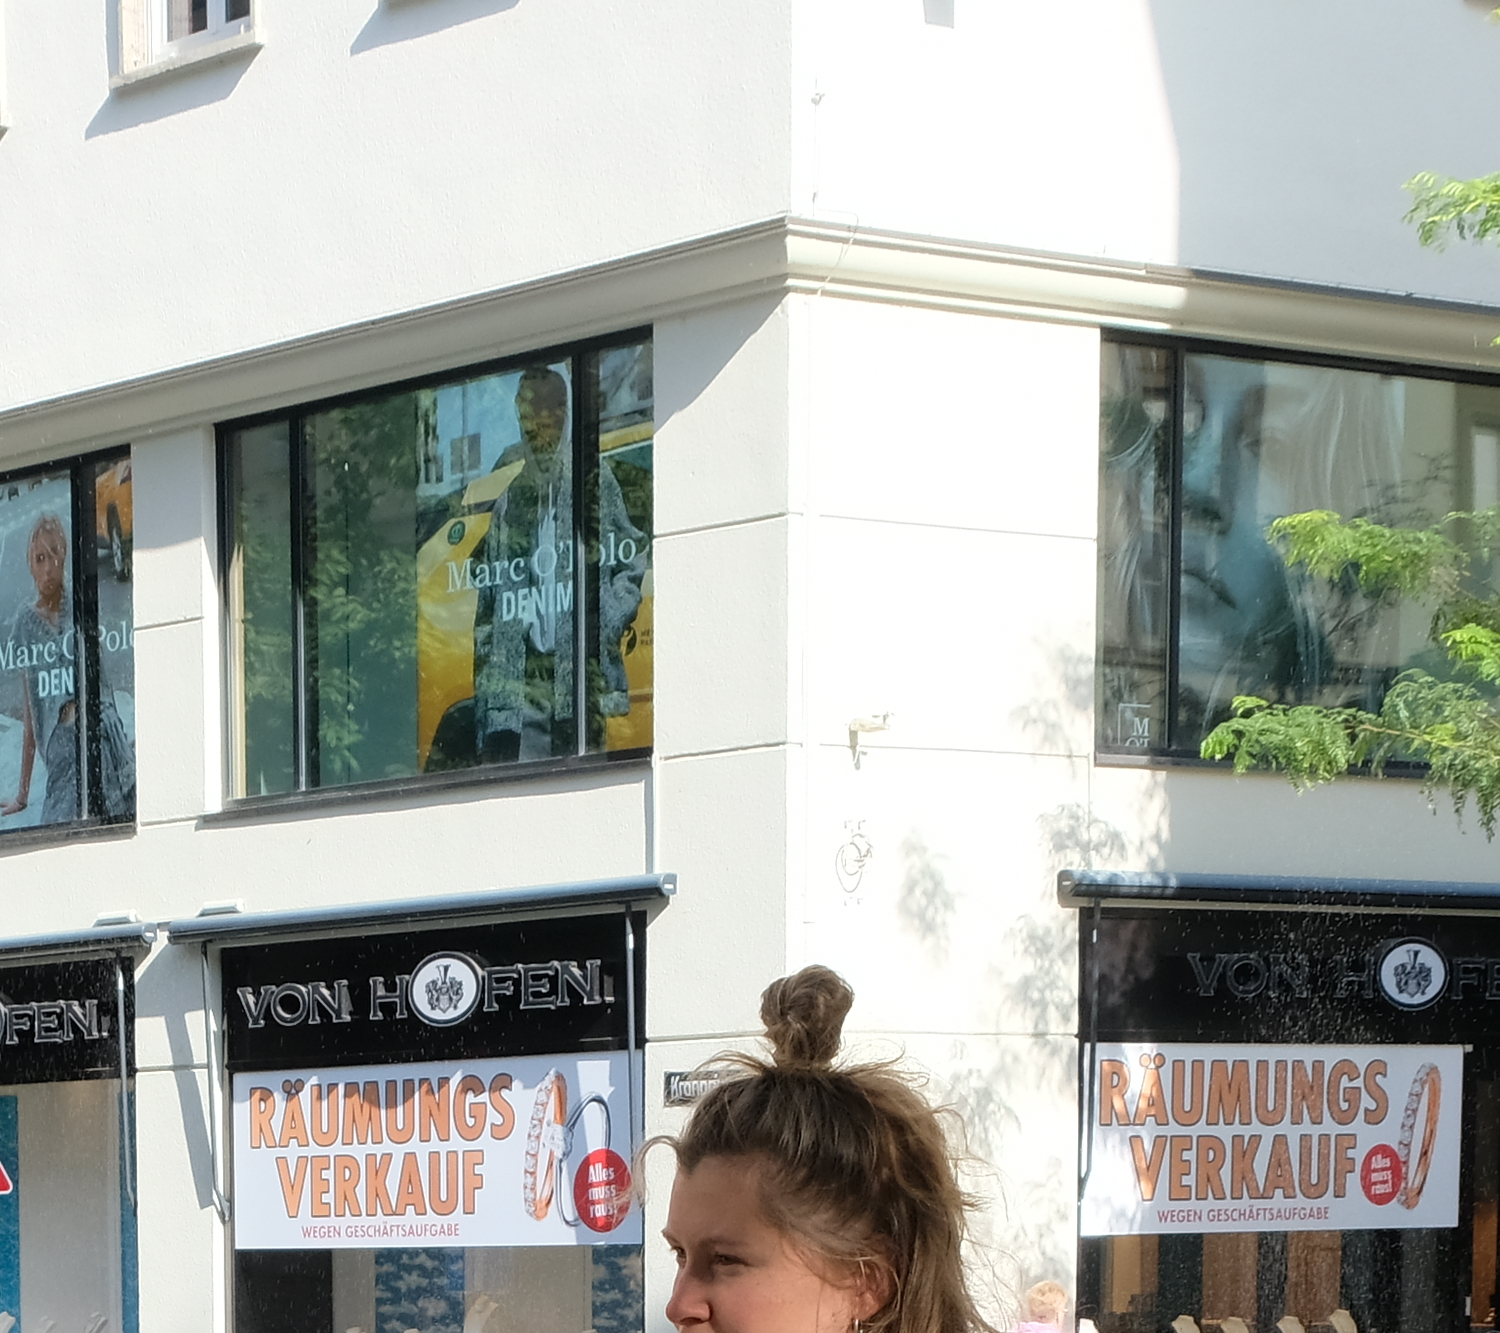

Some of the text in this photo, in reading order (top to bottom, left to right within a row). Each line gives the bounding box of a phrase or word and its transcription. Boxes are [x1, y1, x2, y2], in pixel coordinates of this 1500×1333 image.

[446, 556, 526, 594] Marc
[37, 665, 75, 698] DEN
[1187, 951, 1307, 998] VON
[237, 979, 350, 1028] VON
[1098, 1052, 1388, 1127] RÄUMUNGS
[249, 1073, 516, 1150] RÄUMUNGS
[275, 1149, 486, 1219] VERKAUF
[588, 1162, 615, 1183] Alles
[1130, 1133, 1358, 1202] VERKAUF
[588, 1185, 617, 1201] muss
[301, 1219, 460, 1240] WEGEN GESCHÄFTSAUFGABE
[1157, 1205, 1331, 1224] WEGEN GESCHÄFTSAUFGABE
